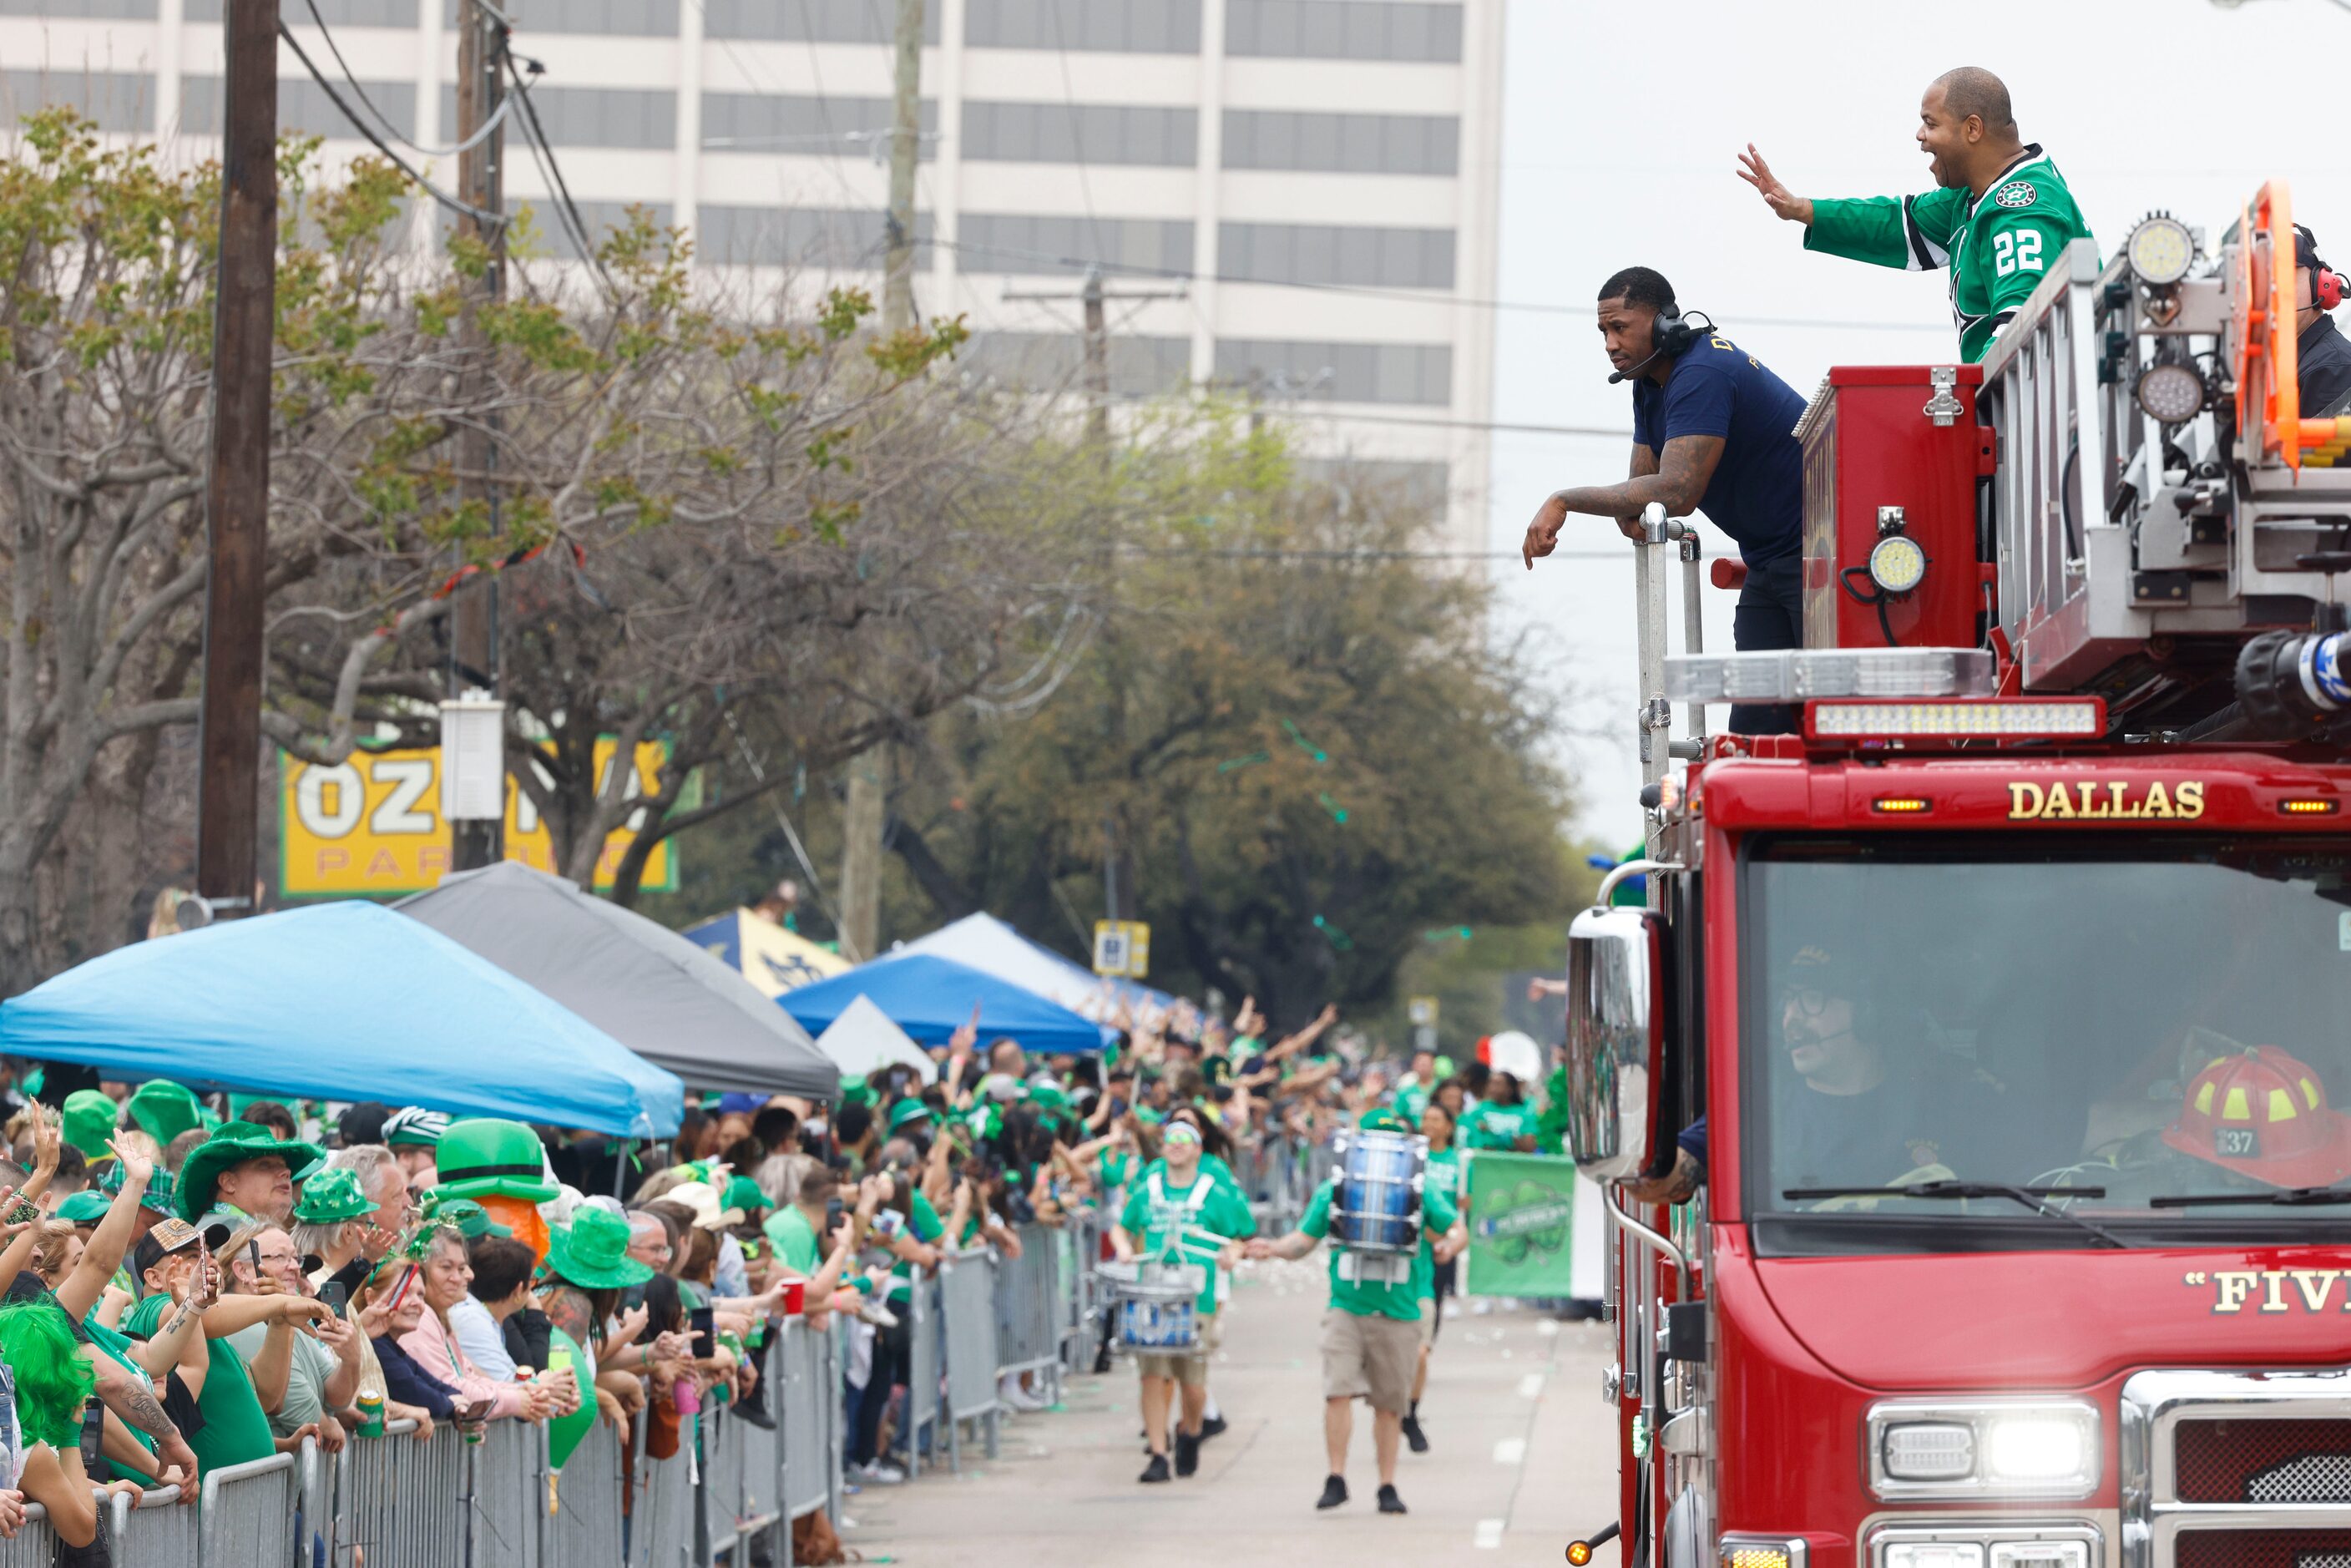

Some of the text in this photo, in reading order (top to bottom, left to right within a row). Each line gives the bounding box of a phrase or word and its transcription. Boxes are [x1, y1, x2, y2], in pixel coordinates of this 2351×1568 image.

[1999, 183, 2033, 197] DALLAS
[1994, 230, 2043, 277] 22
[2008, 781, 2205, 820] DALLAS
[2227, 1130, 2253, 1153] 37
